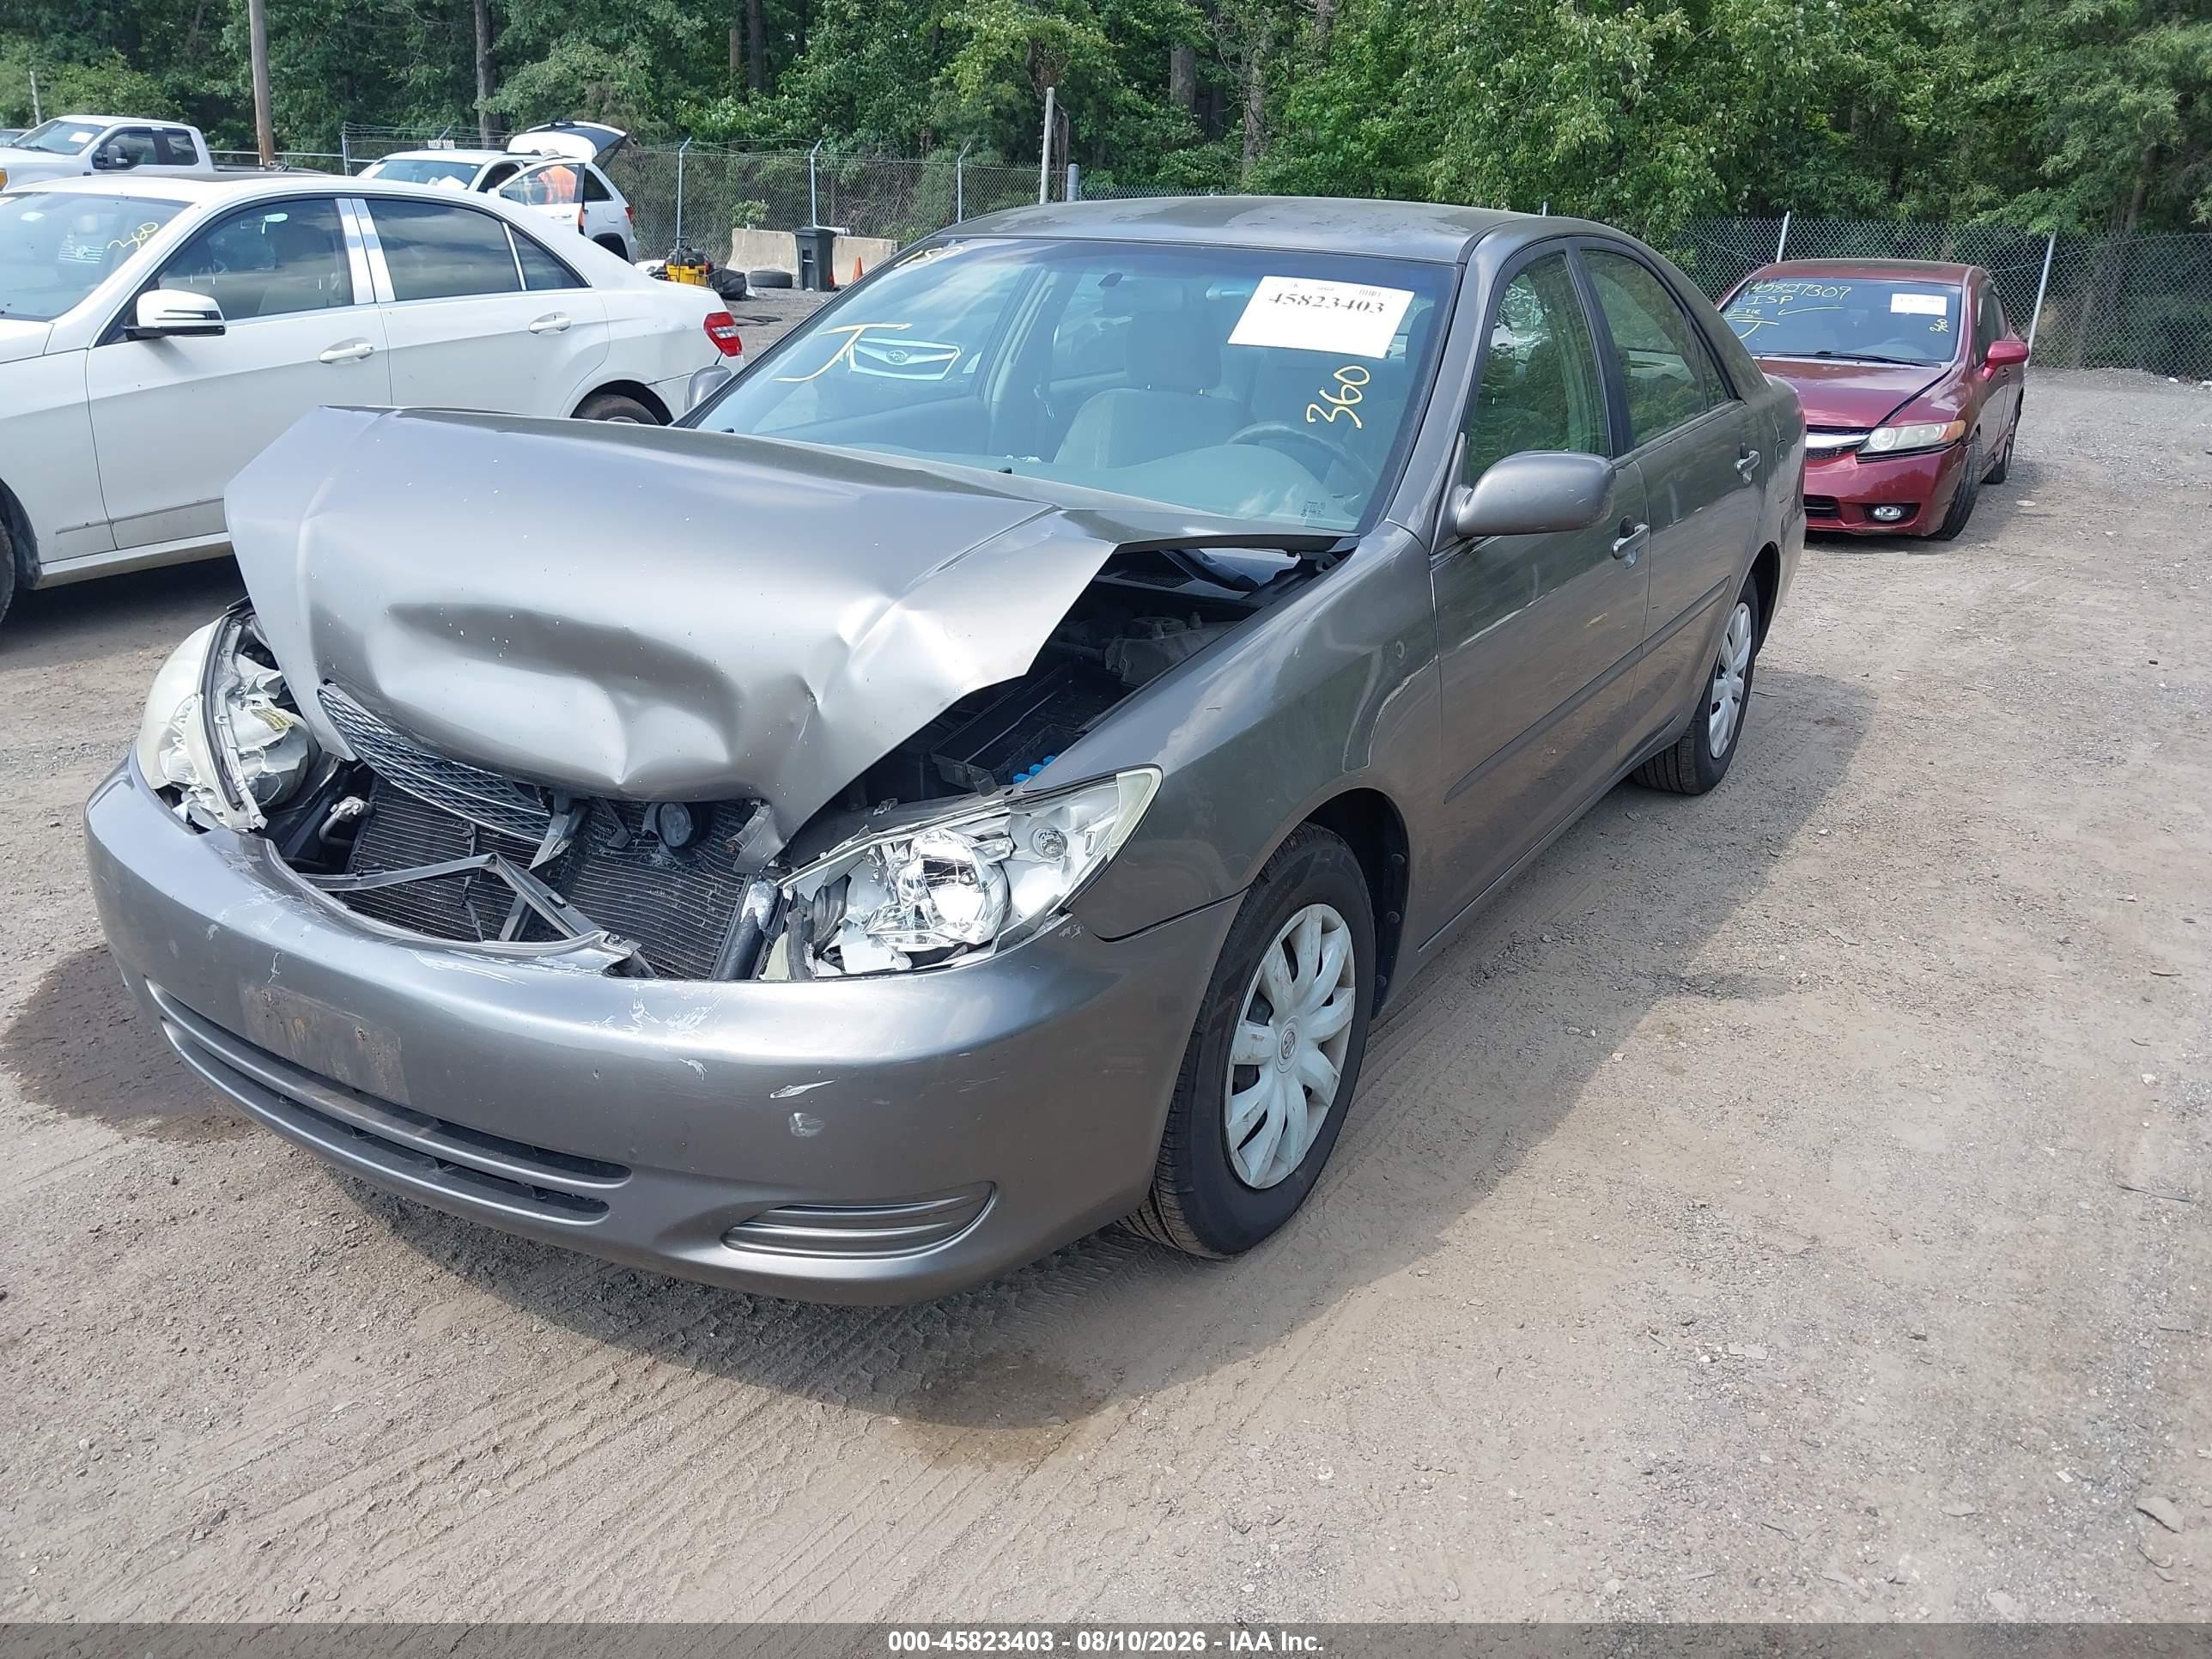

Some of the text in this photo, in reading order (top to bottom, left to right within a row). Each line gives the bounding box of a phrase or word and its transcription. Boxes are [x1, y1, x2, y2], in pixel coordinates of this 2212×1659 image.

[106, 222, 159, 250] 360
[1746, 295, 1794, 305] ISP
[1751, 282, 1852, 301] 45827309
[1268, 292, 1385, 314] 45823403
[1305, 365, 1370, 429] 360
